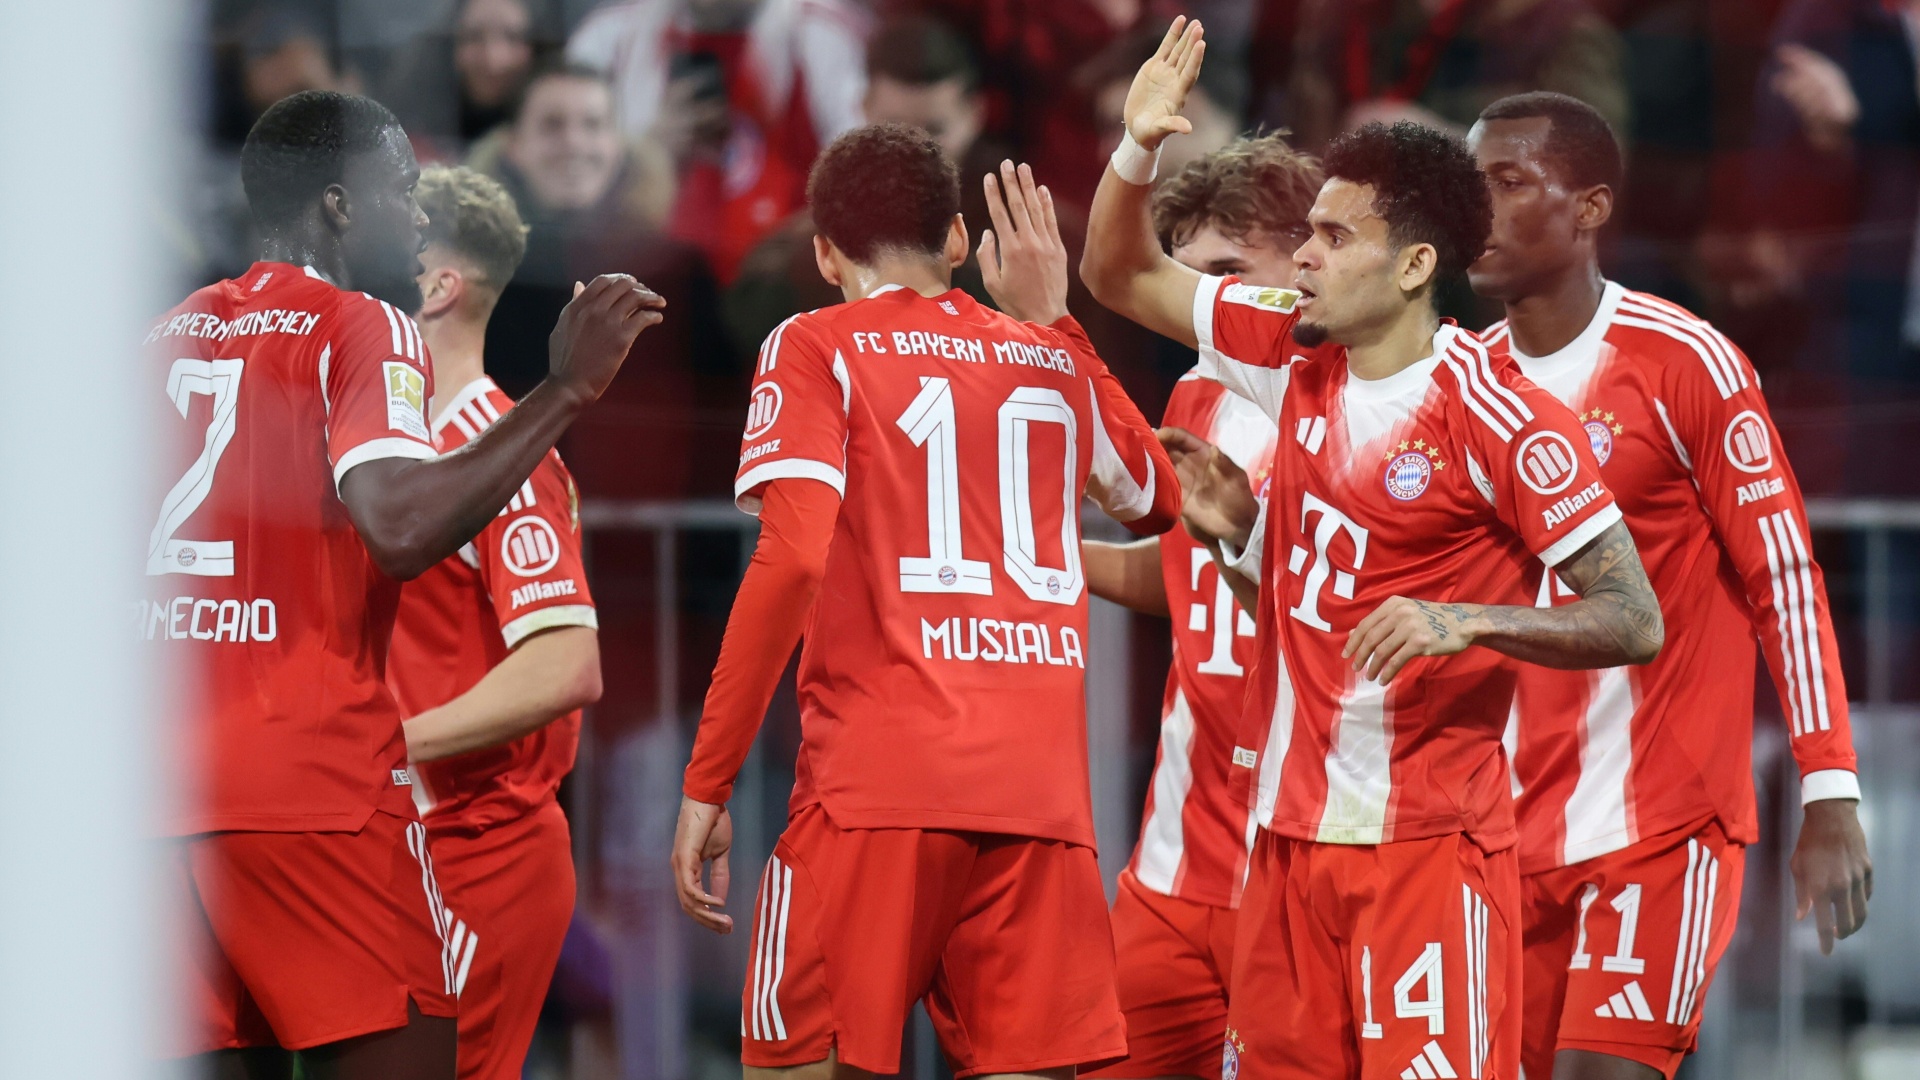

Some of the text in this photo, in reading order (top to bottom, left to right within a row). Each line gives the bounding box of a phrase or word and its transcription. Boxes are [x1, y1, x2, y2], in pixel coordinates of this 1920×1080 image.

[142, 321, 168, 346] FC
[162, 312, 235, 342] BAYERN
[853, 332, 1076, 377] FC BAYERN MÜNCHEN
[145, 358, 244, 576] 2
[895, 376, 1084, 606] 10
[1392, 456, 1428, 476] FC BAYERN
[1541, 480, 1605, 531] Allianz
[1288, 490, 1369, 633] T
[511, 579, 577, 610] Allianz
[921, 617, 1085, 669] MUSIALA
[1568, 883, 1646, 975] 11
[1361, 942, 1446, 1039] 14
